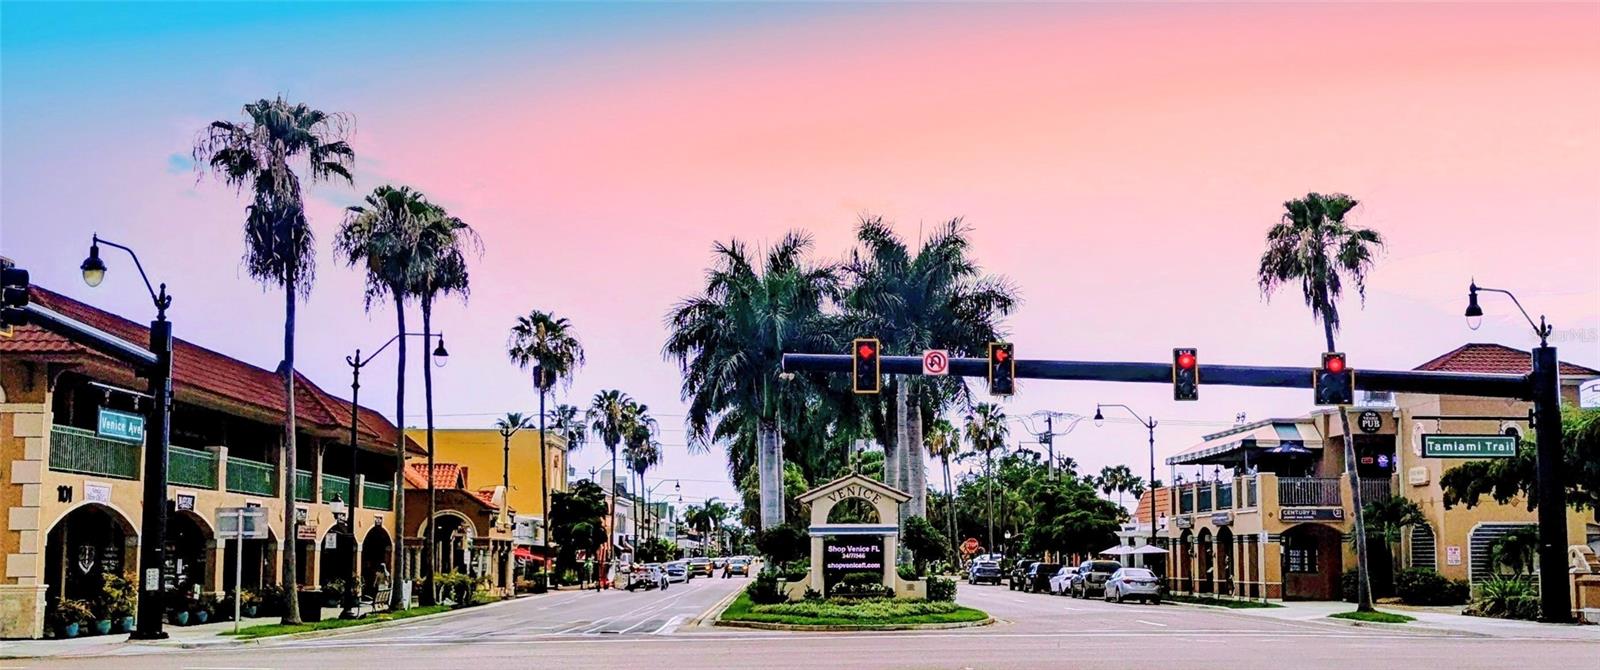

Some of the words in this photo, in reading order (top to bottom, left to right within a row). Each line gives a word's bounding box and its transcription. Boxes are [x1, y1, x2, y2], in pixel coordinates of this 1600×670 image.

[102, 416, 126, 432] Venice
[128, 421, 142, 436] Ave
[1362, 420, 1380, 428] PUB
[1428, 441, 1480, 451] Tamiami
[1485, 441, 1514, 451] Trail
[57, 485, 73, 503] 101
[828, 486, 881, 505] VENICE
[828, 545, 846, 553] Shop
